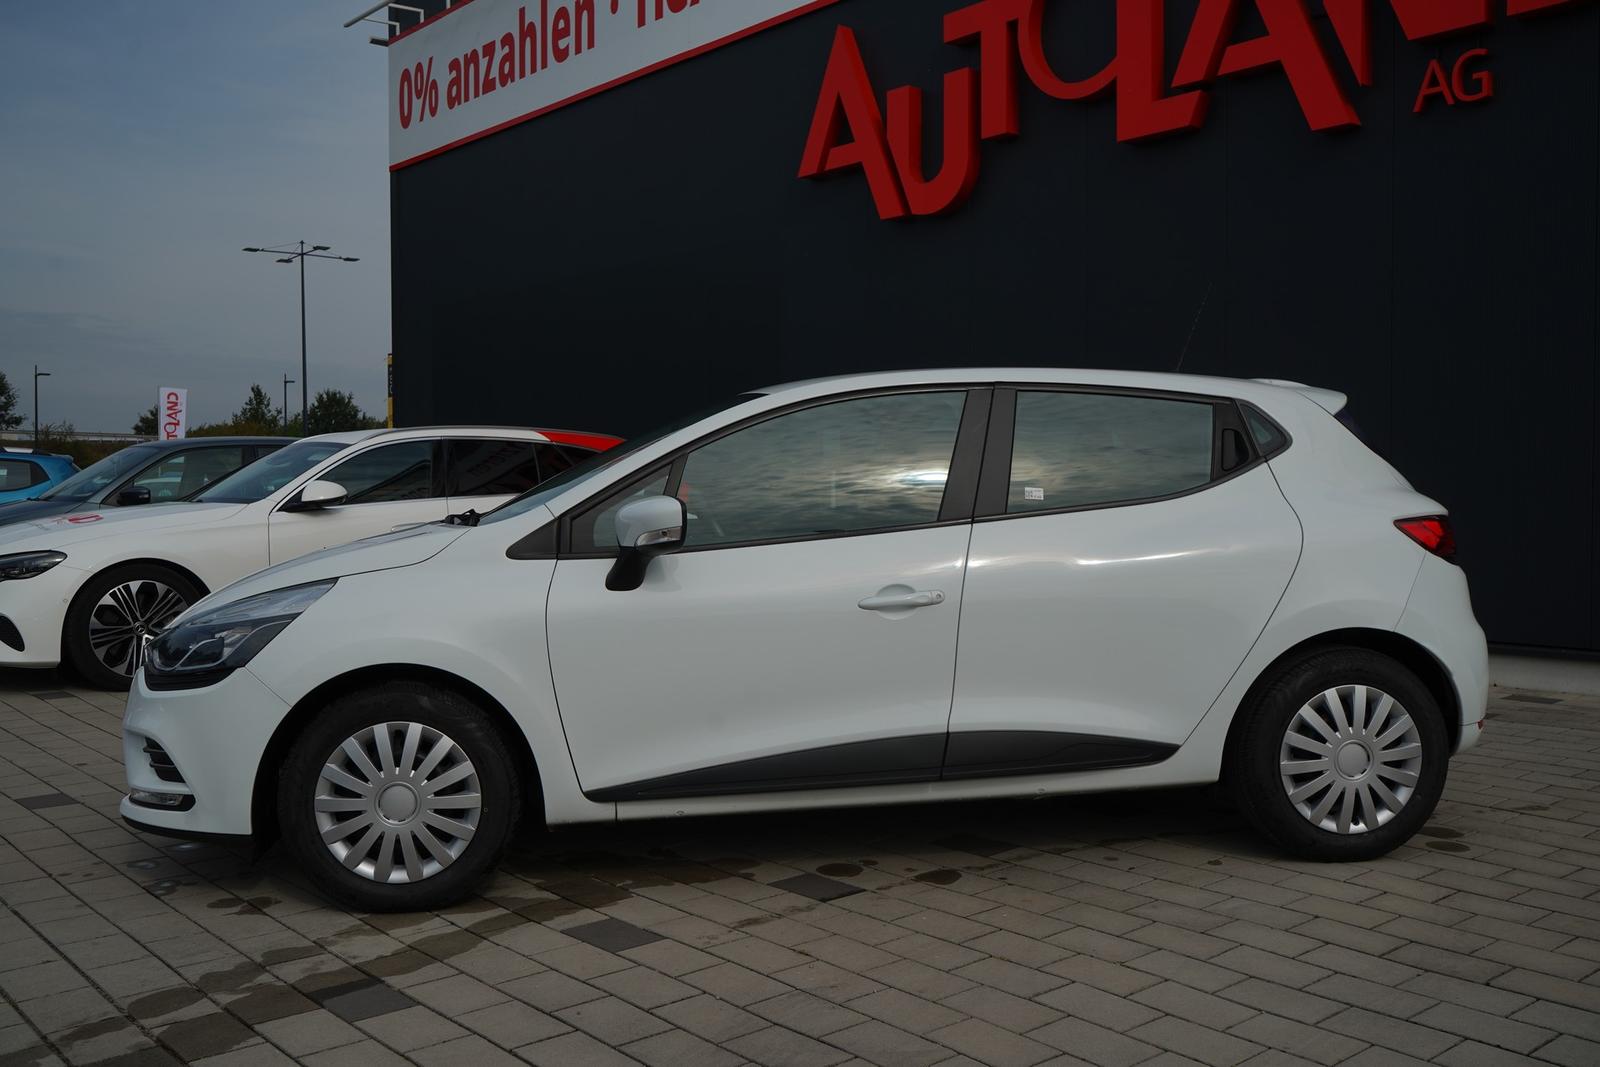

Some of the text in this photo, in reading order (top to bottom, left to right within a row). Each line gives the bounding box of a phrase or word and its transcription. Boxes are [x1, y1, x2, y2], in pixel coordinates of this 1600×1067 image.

[399, 0, 595, 129] 0% anzahlen
[798, 0, 1598, 220] AUTOLA
[1413, 48, 1494, 113] AG
